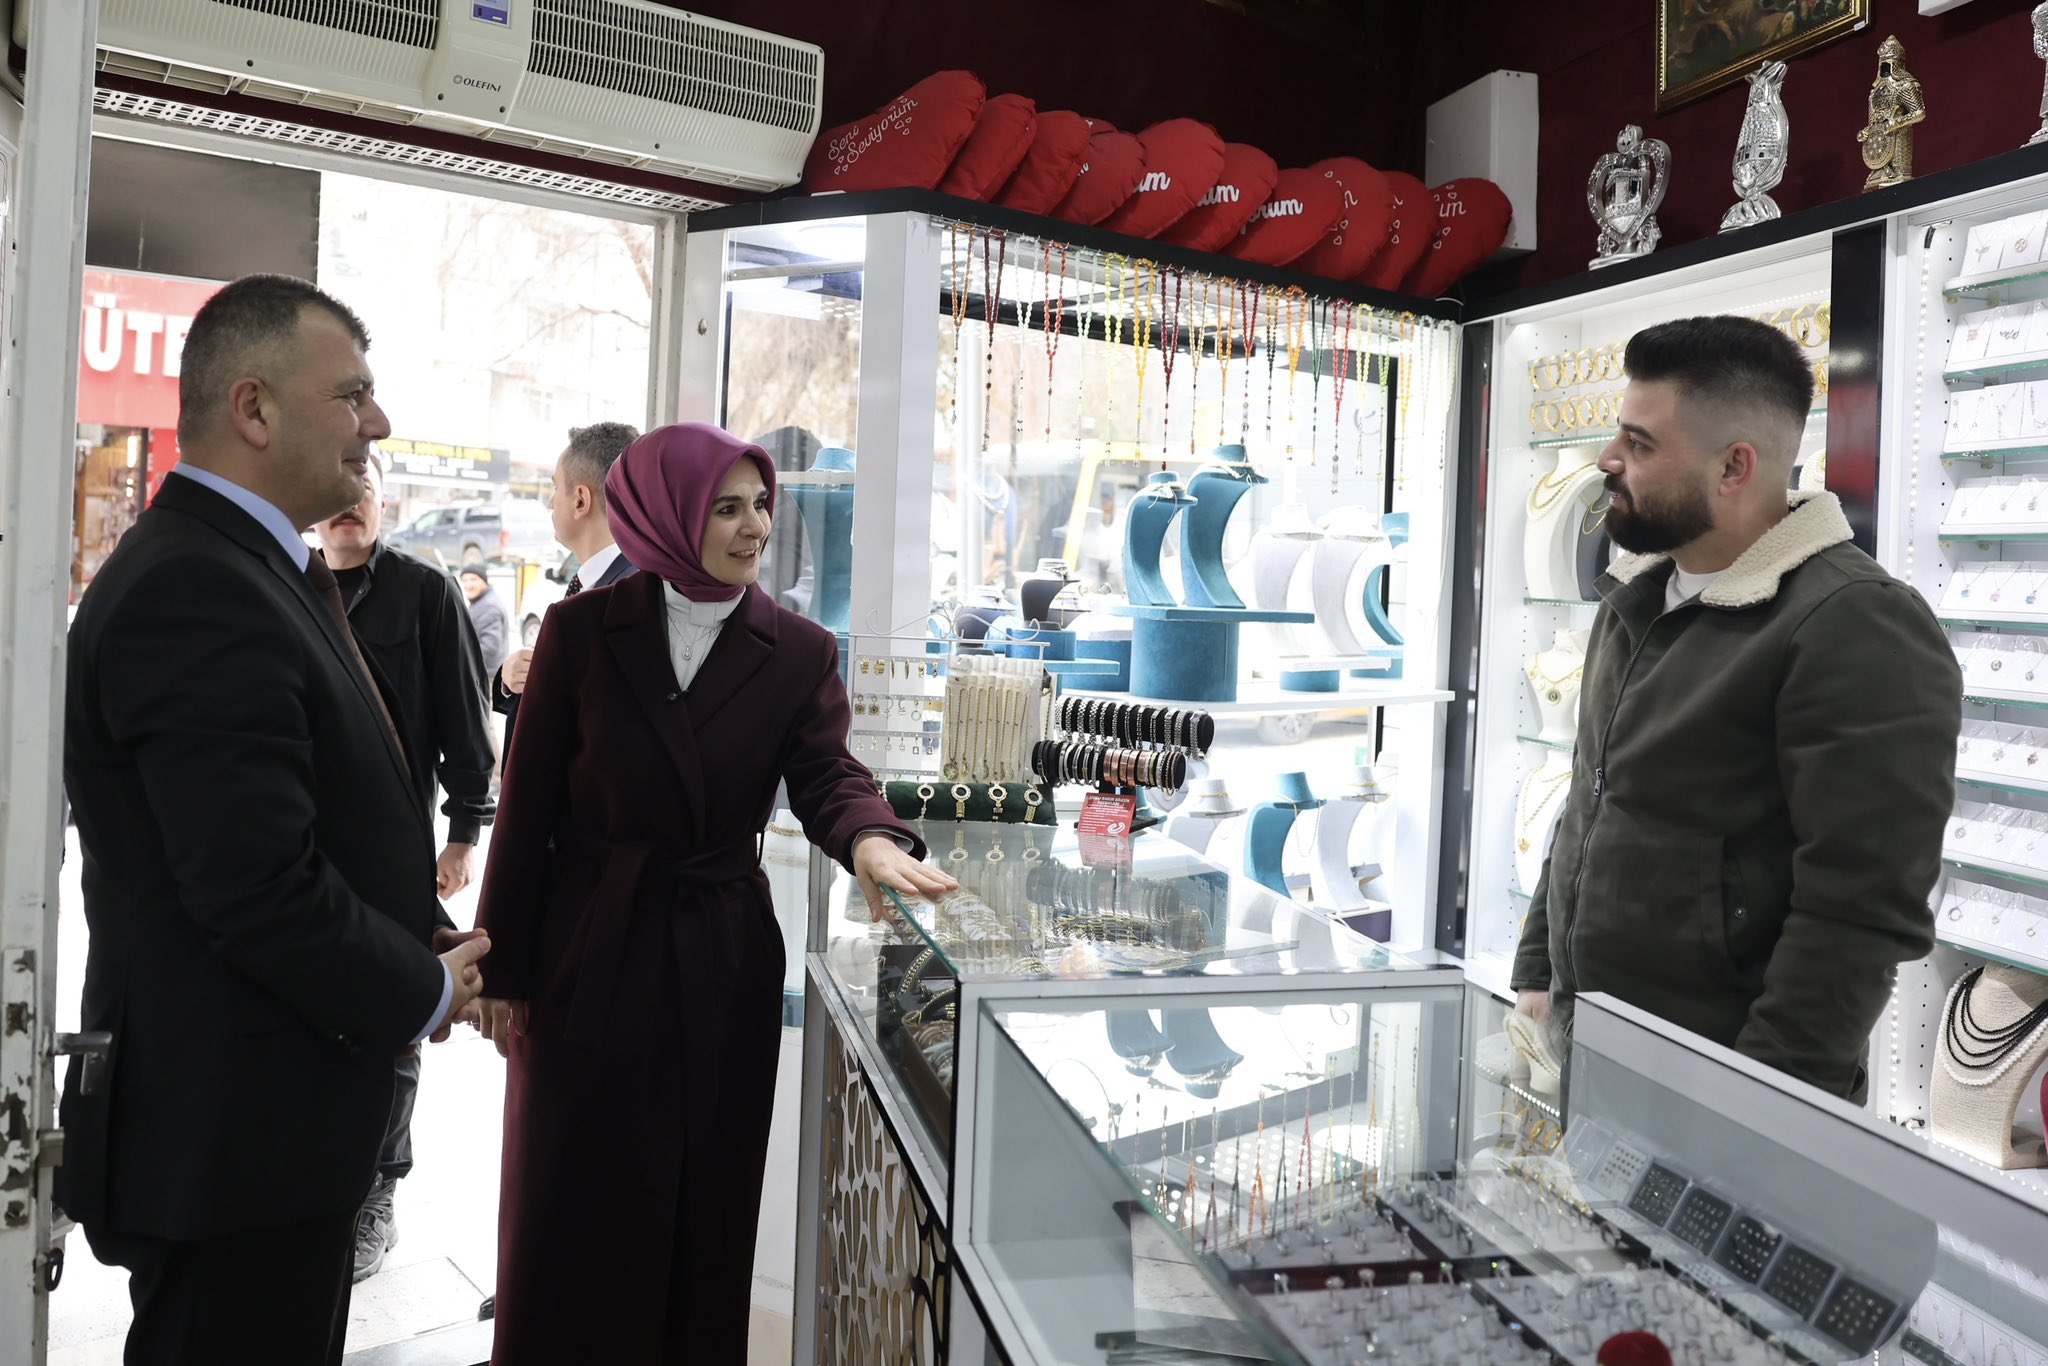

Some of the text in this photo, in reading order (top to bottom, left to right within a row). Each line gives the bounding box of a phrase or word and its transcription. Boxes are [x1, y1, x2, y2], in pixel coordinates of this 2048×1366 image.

[463, 77, 502, 92] OLEFINI
[828, 125, 860, 160] Seni
[846, 98, 918, 163] Seviyorum
